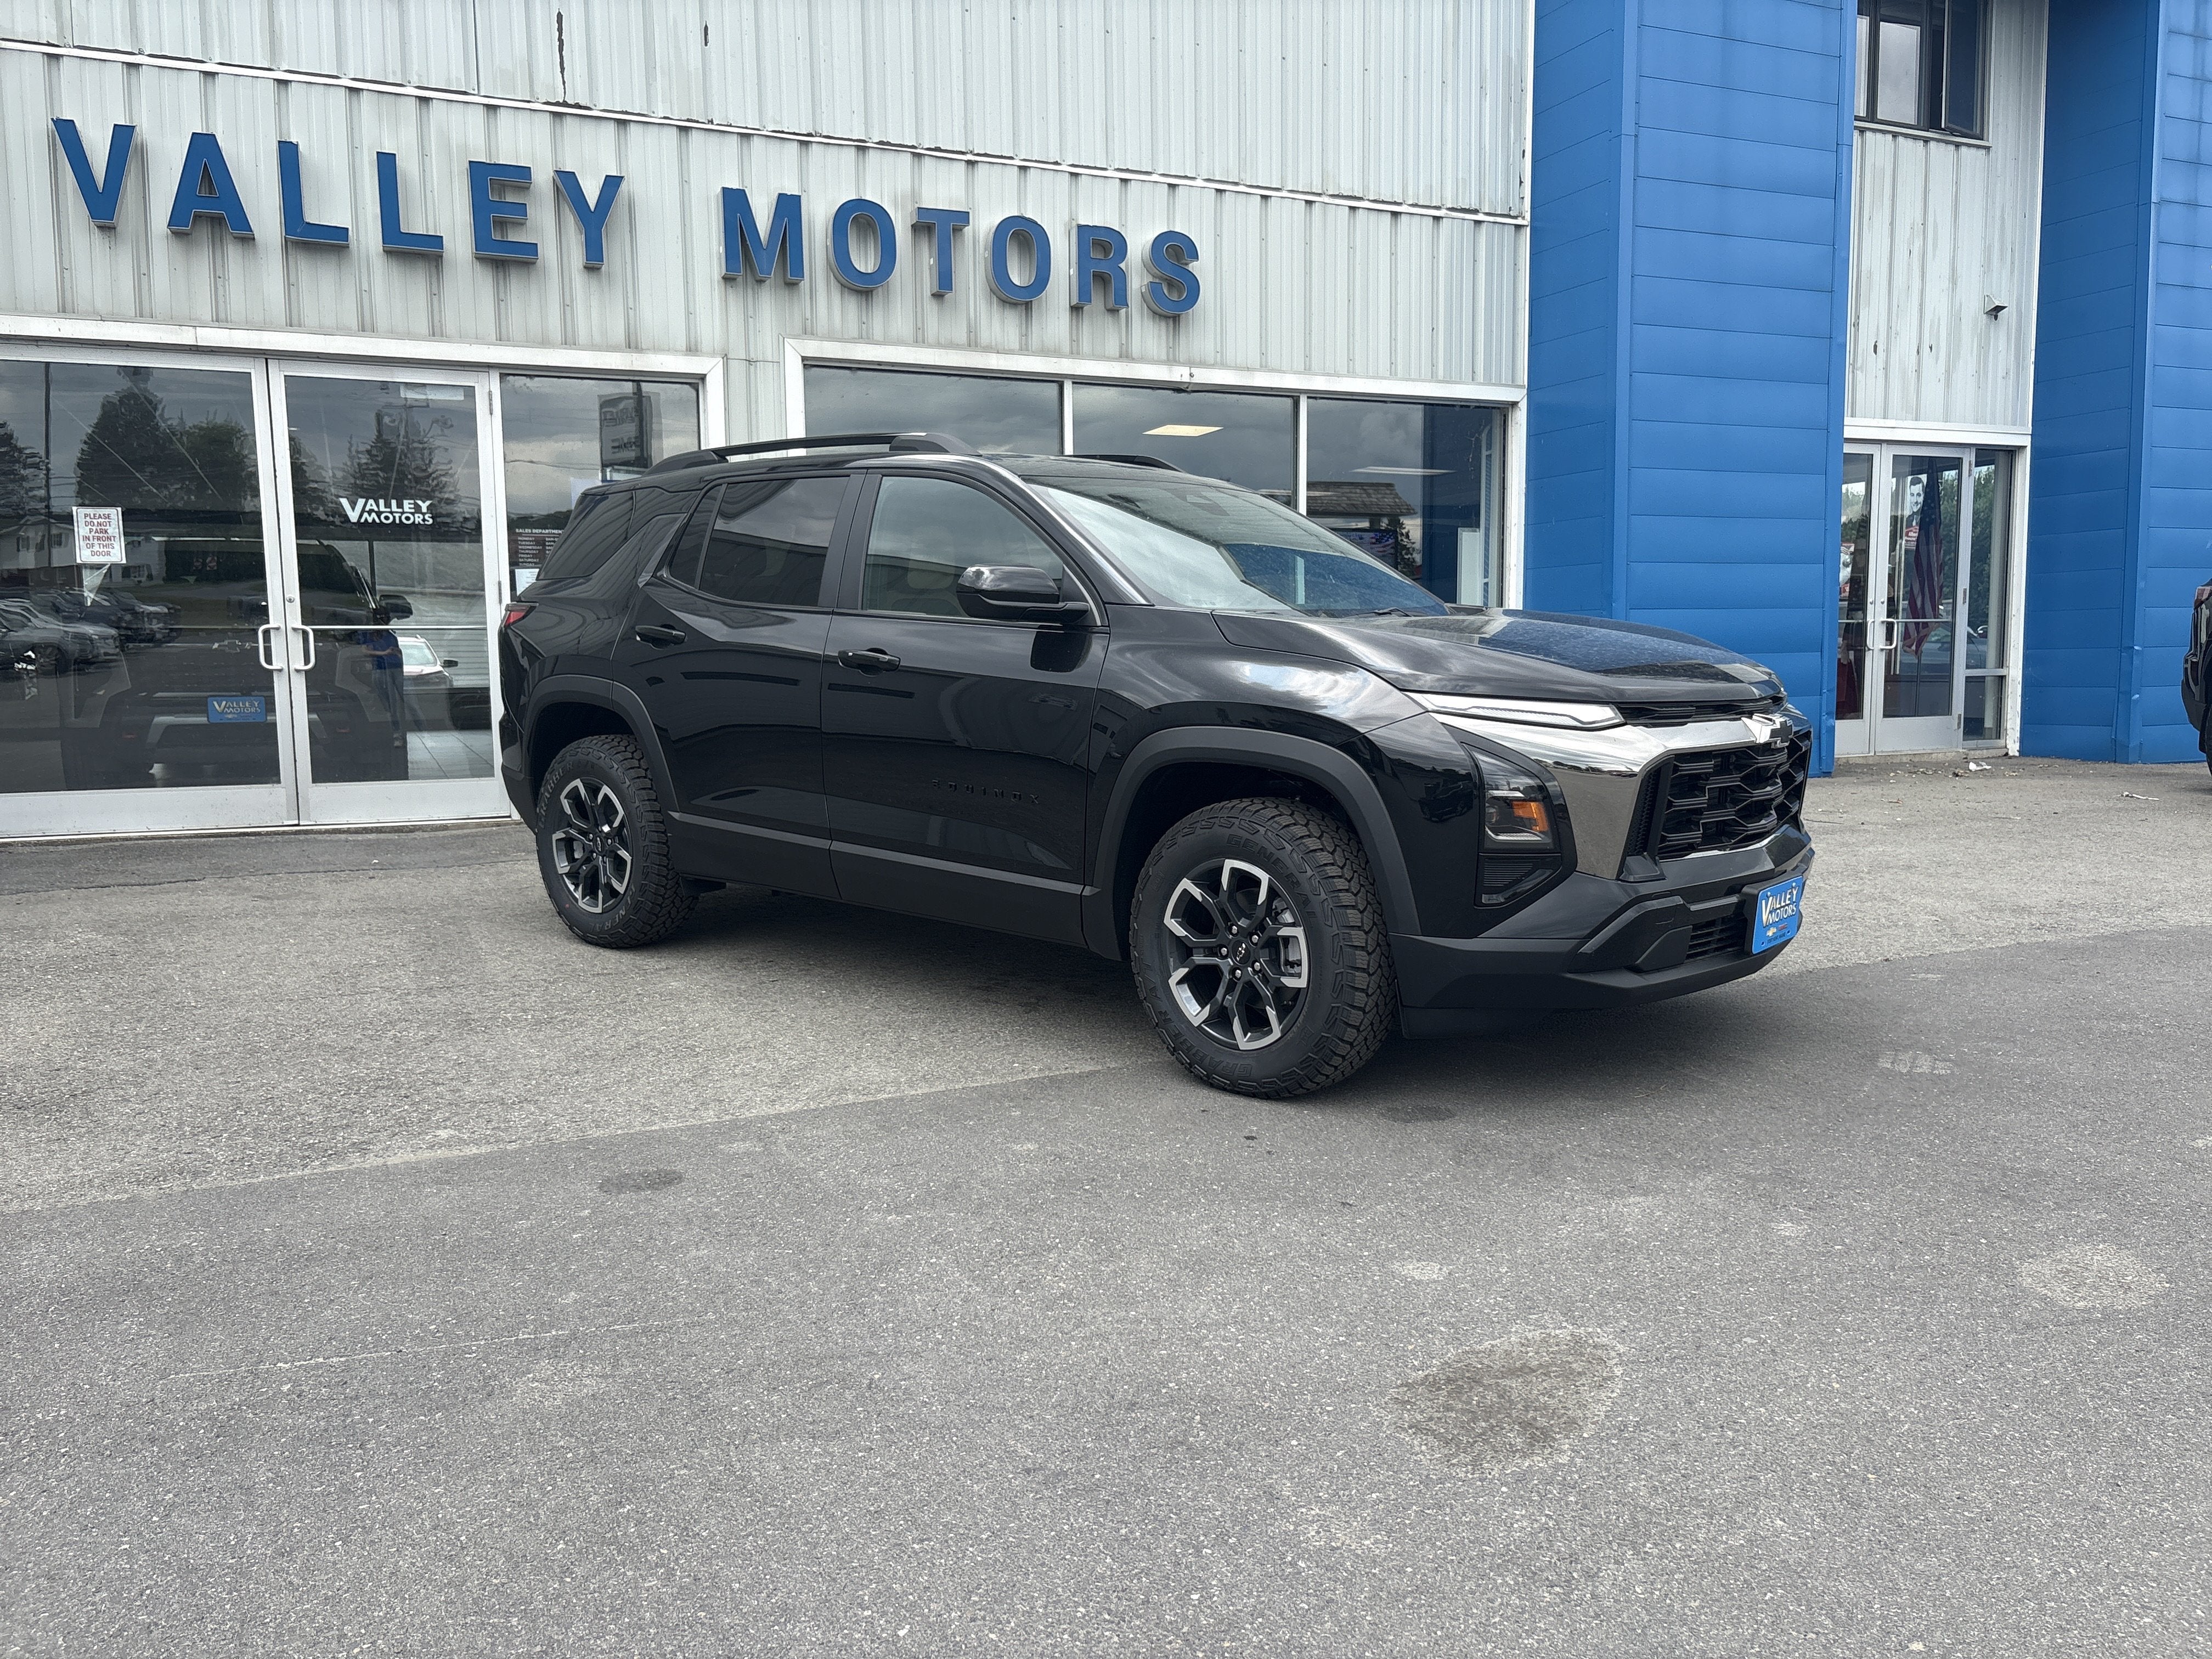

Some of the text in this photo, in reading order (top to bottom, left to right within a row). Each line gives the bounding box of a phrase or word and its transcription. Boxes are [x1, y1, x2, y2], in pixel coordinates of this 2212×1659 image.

[51, 117, 1201, 317] VALLEY MOTORS
[339, 498, 432, 523] VALLEY
[360, 512, 433, 525] MOTORS
[213, 701, 259, 713] VALLEY
[932, 780, 1039, 804] EQUINOX
[1227, 833, 1318, 928] GENERAL
[1762, 886, 1799, 927] VALLEY
[1767, 903, 1797, 926] MOTORS
[1158, 1009, 1253, 1076] GRABBER
